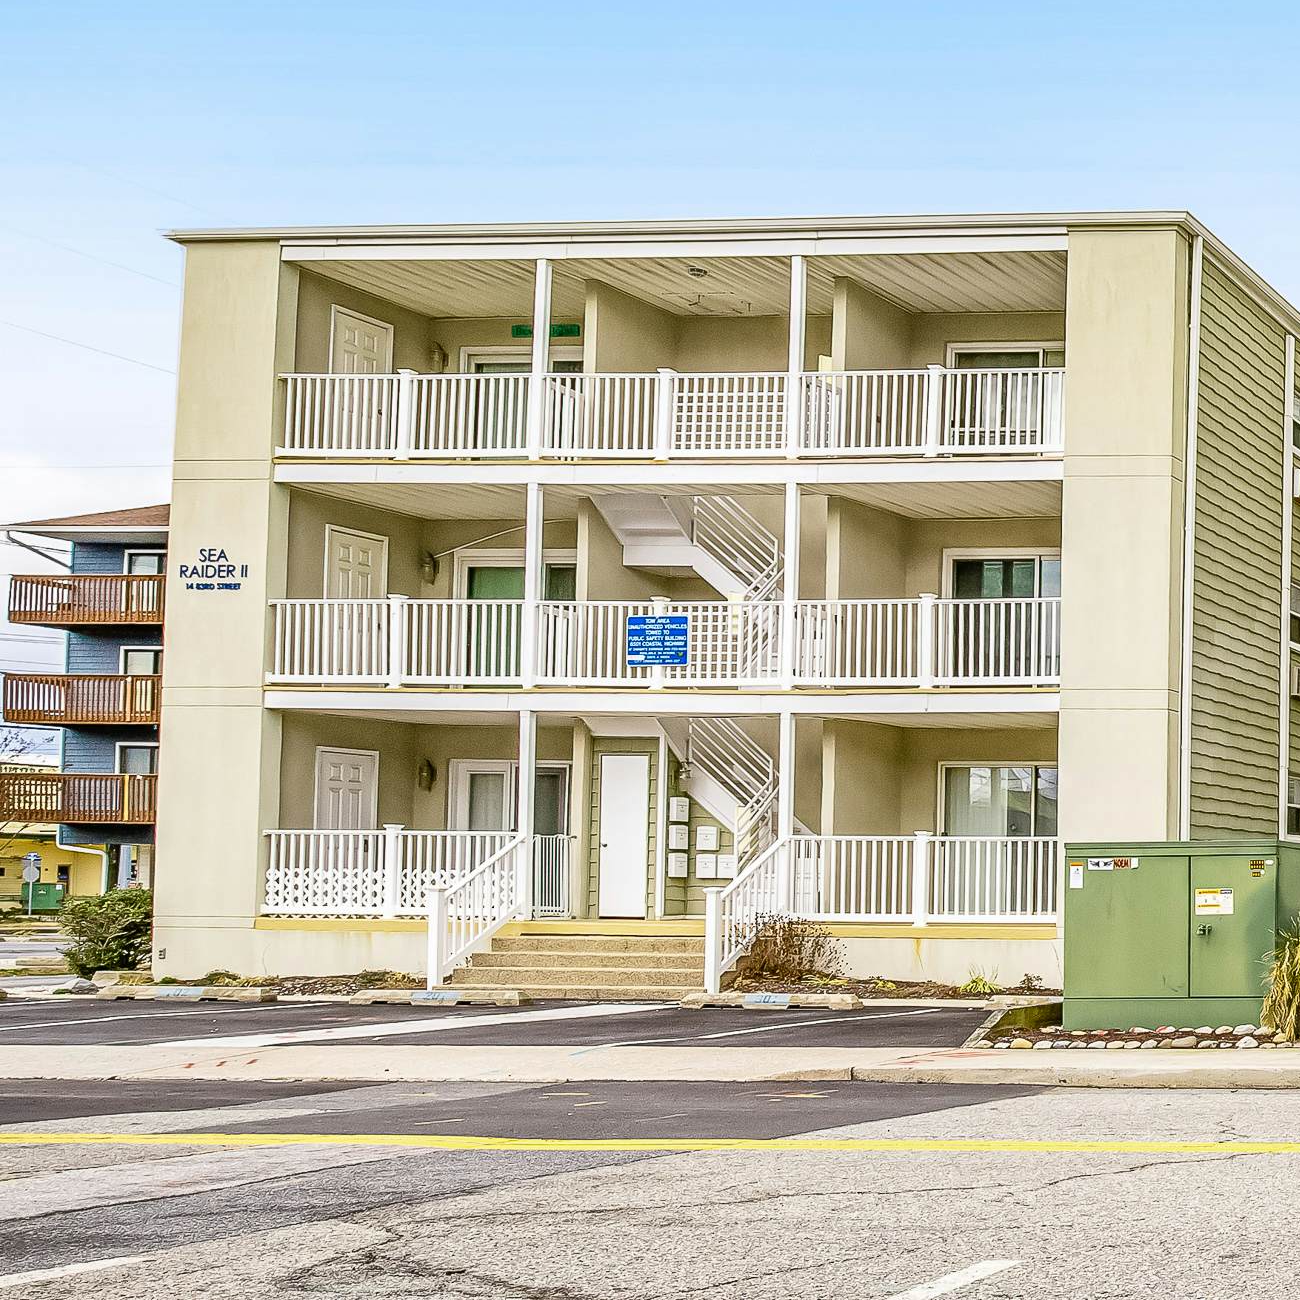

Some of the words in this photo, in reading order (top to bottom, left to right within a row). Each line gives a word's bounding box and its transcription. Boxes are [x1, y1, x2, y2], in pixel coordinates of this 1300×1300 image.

[198, 548, 229, 563] SEA
[179, 564, 236, 578] RAIDER
[240, 564, 248, 578] II
